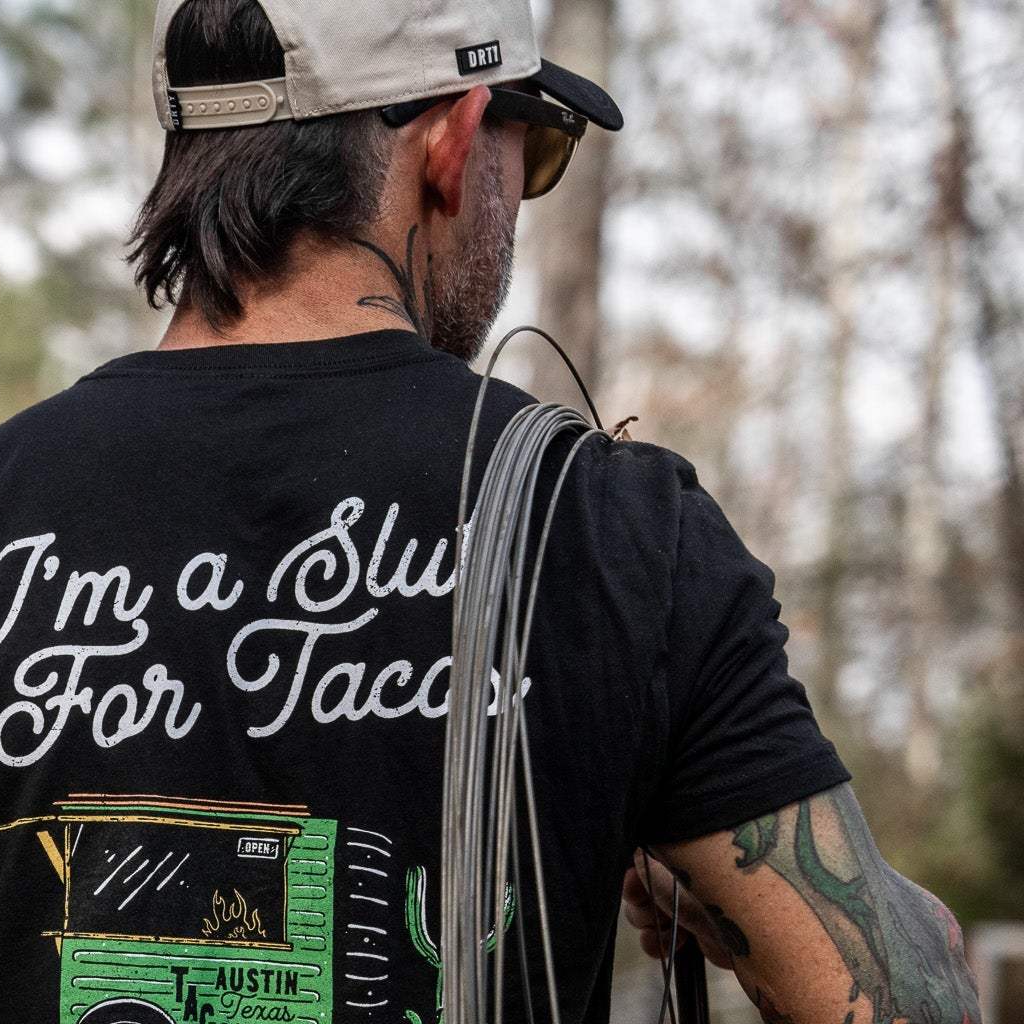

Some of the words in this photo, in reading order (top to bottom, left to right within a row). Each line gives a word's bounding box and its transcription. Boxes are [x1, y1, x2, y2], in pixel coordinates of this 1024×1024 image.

[176, 552, 244, 611] a
[245, 842, 271, 854] OPEN
[215, 966, 299, 996] AUSTIN
[220, 991, 296, 1022] Texas
